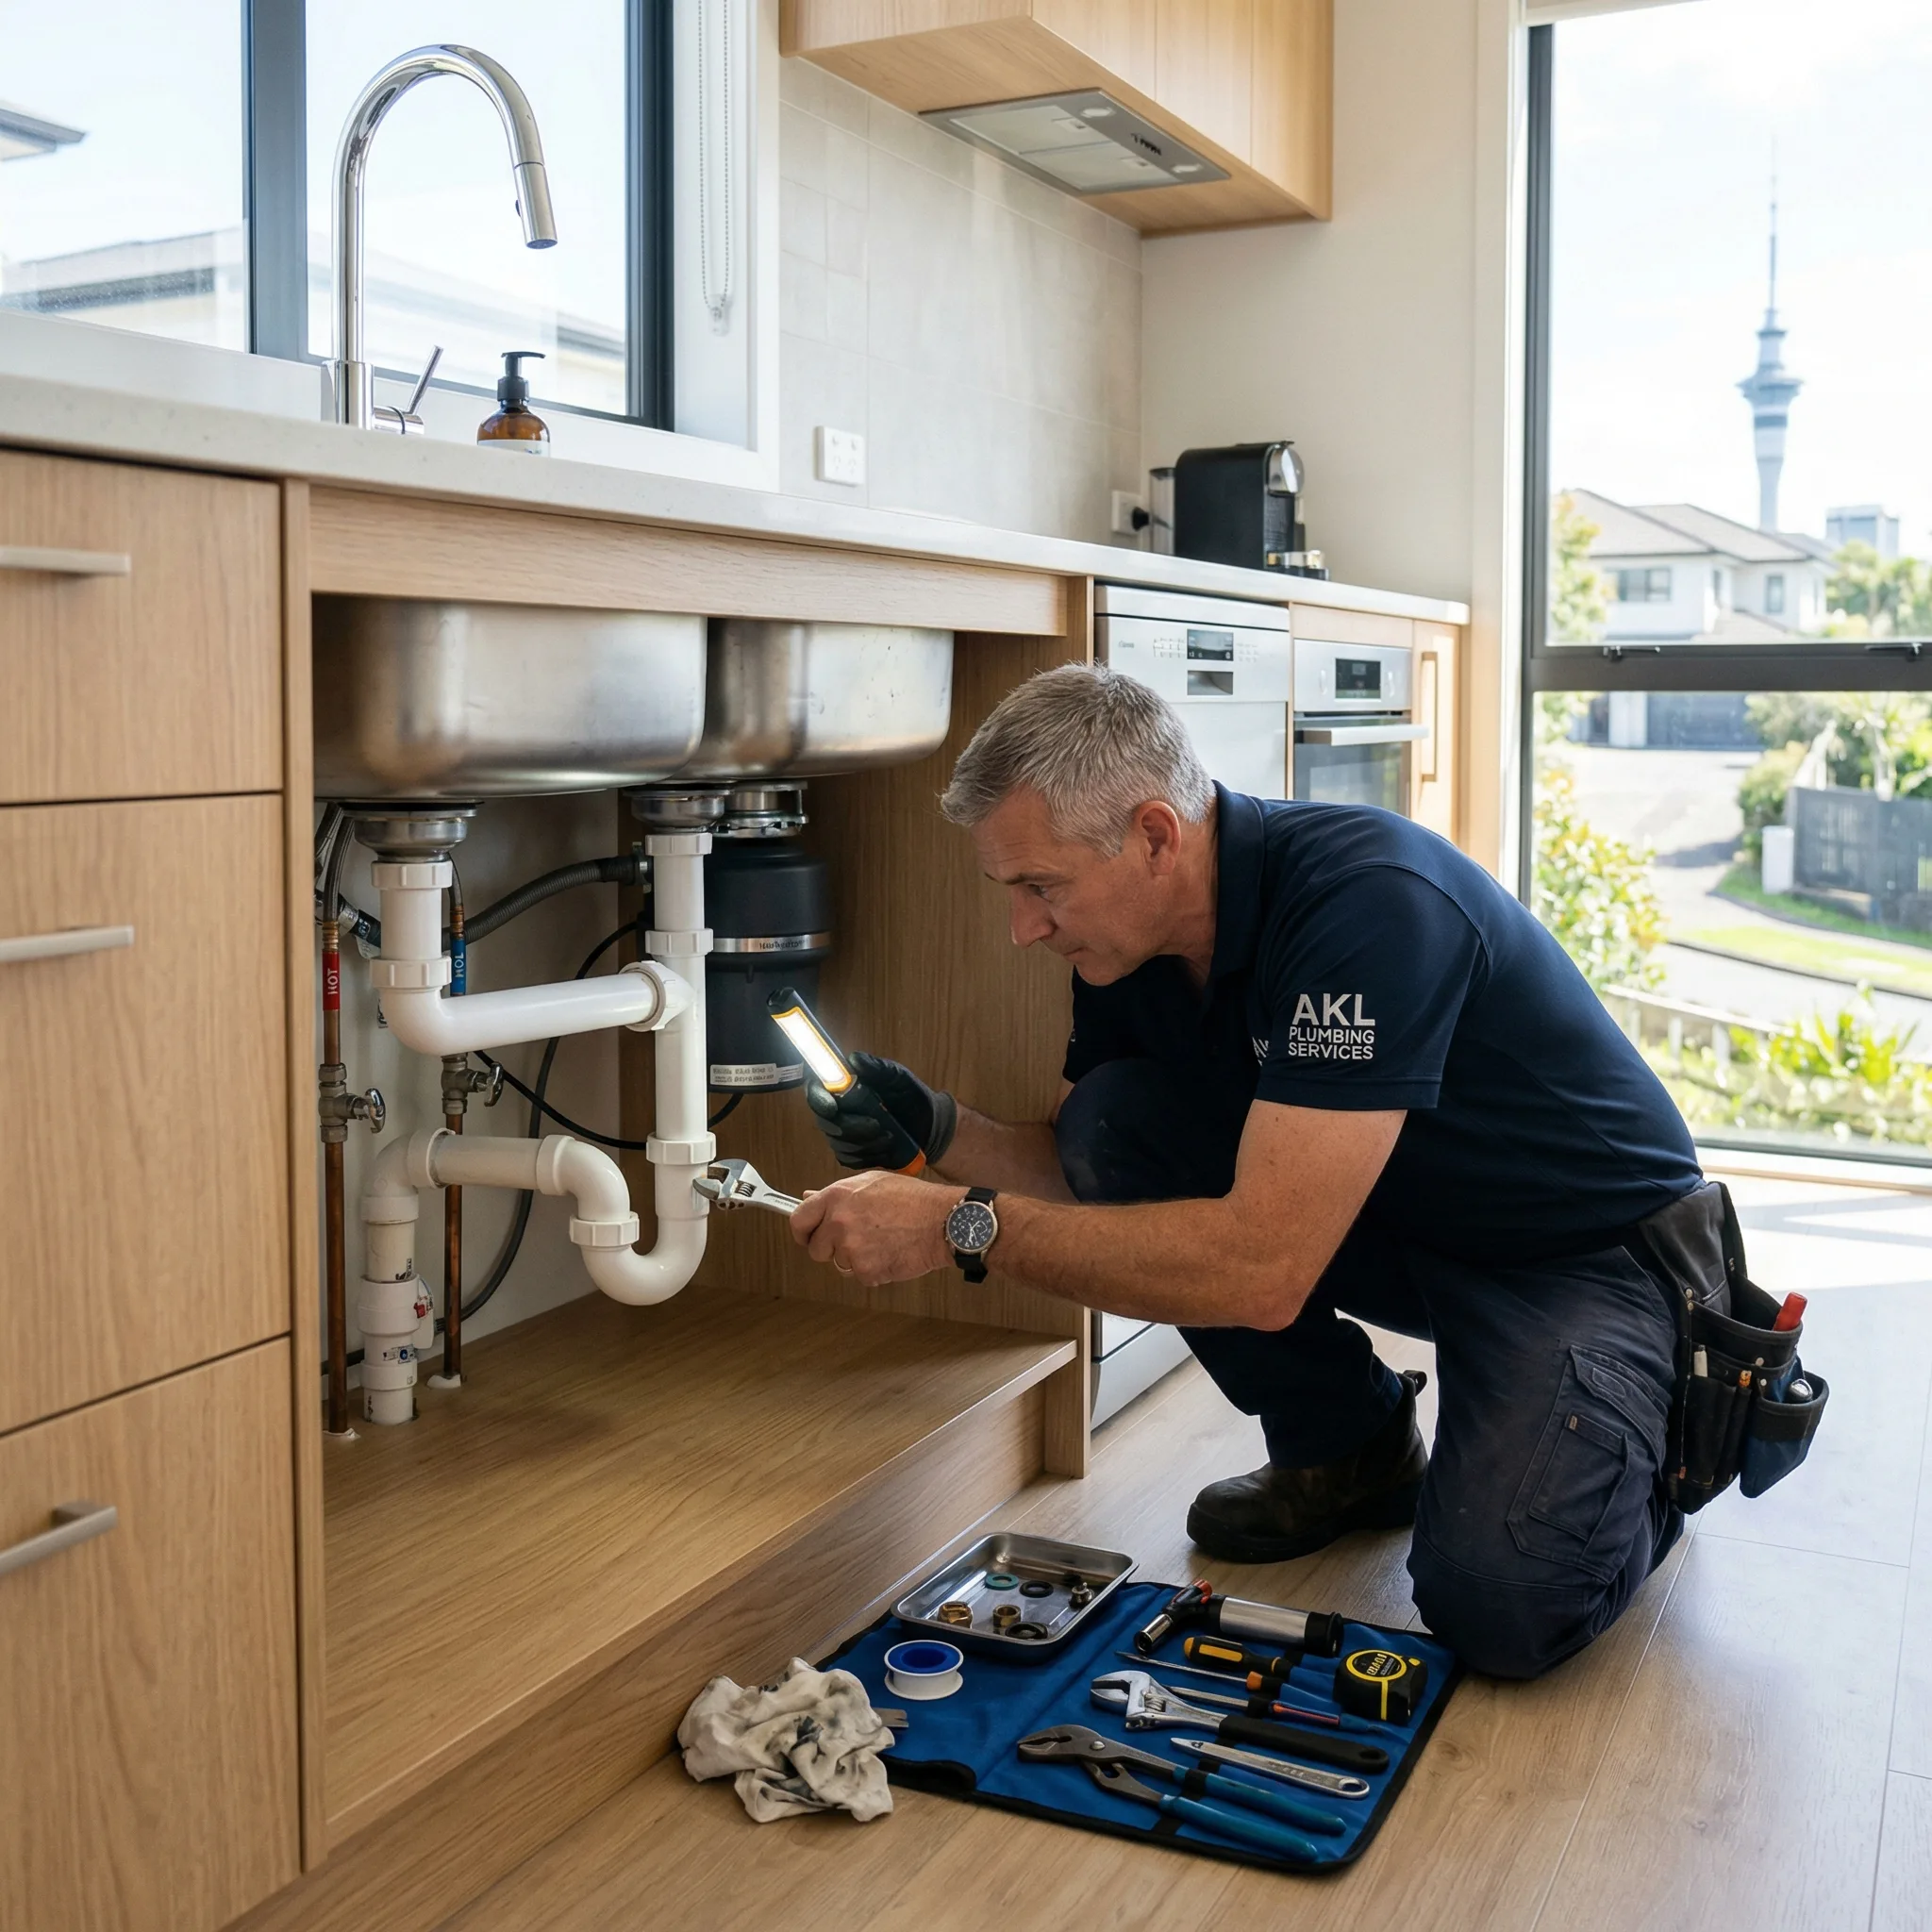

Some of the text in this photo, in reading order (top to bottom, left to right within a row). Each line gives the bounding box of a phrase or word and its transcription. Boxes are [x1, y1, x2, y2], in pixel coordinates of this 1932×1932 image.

[326, 967, 339, 995] HOT
[1291, 992, 1376, 1026] AKL
[1289, 1026, 1375, 1044] PLUMBING
[1288, 1041, 1374, 1060] SERVICES
